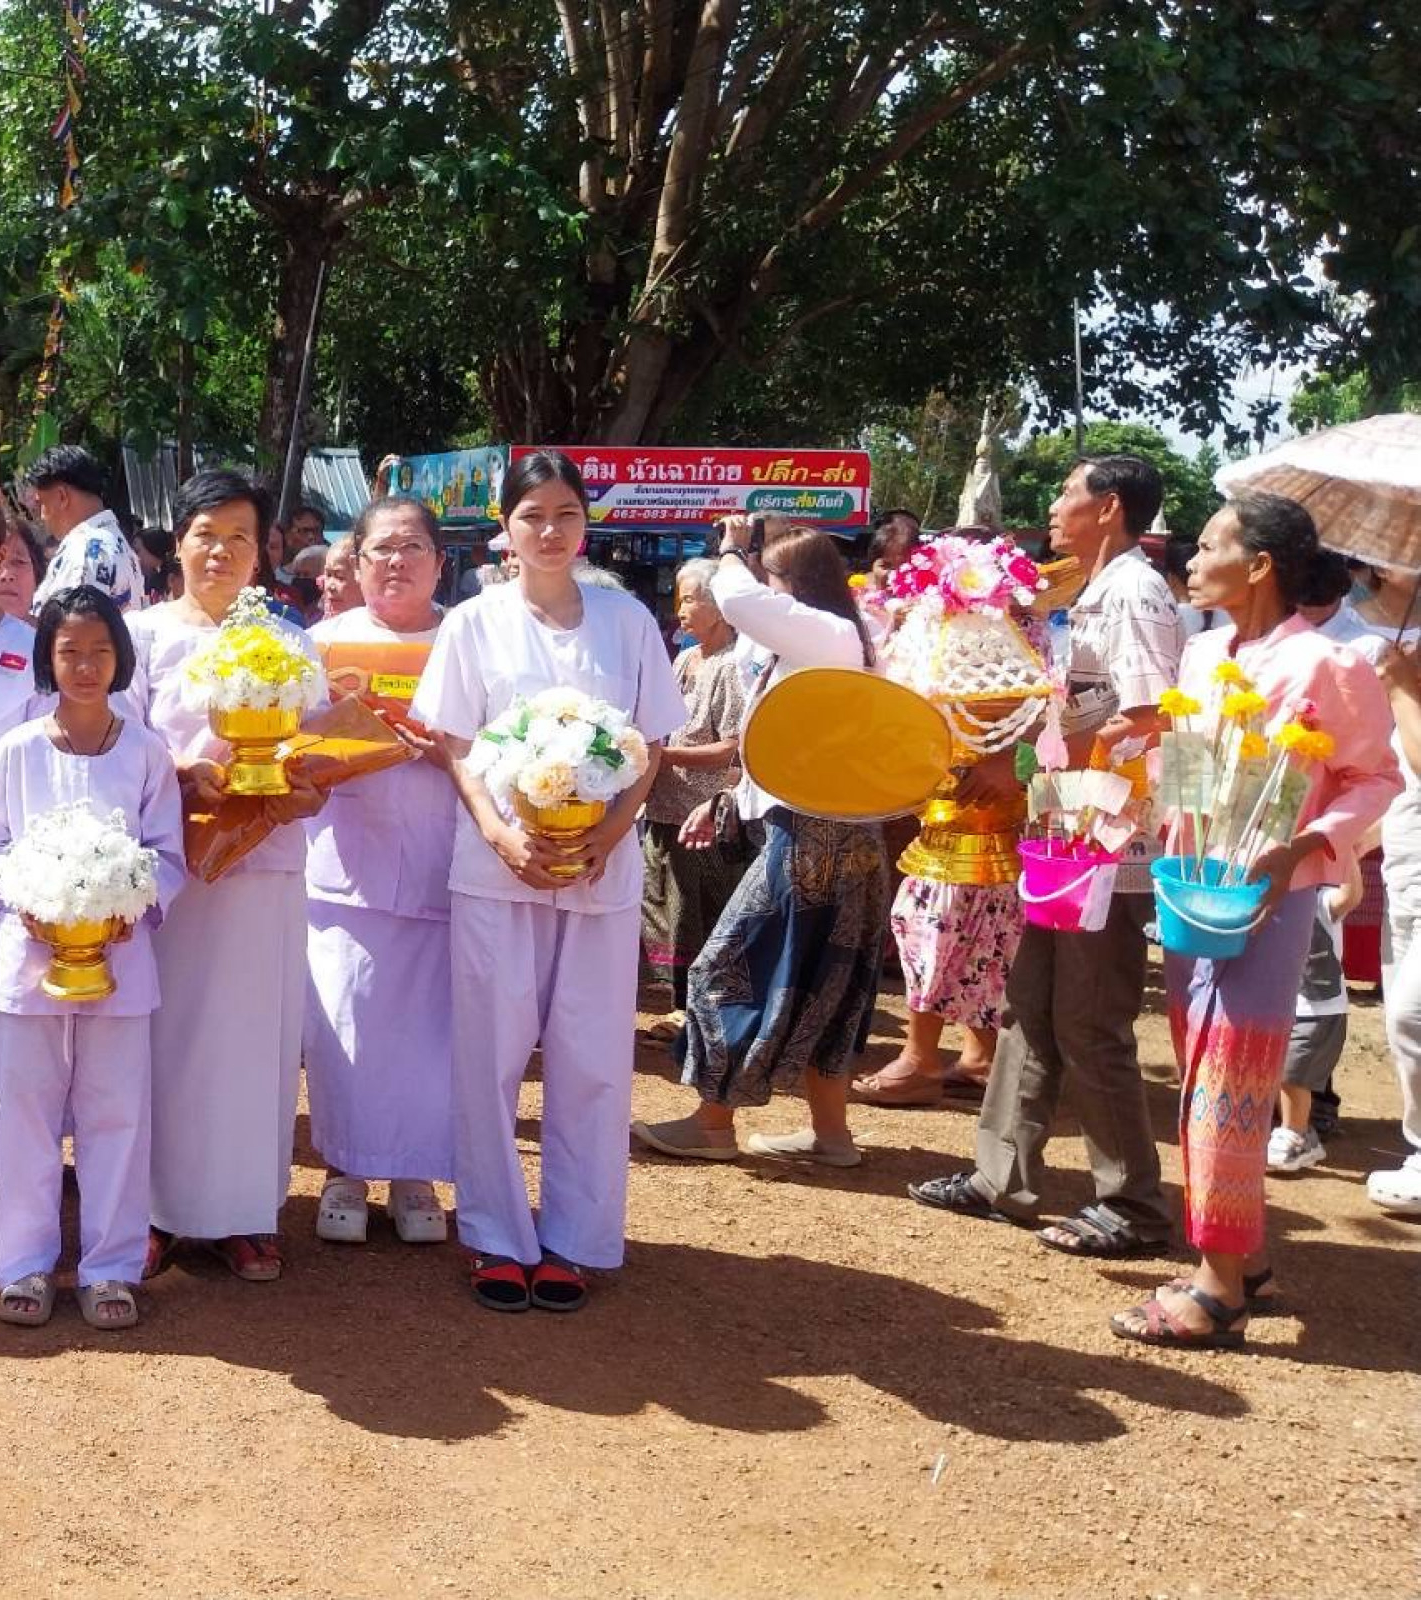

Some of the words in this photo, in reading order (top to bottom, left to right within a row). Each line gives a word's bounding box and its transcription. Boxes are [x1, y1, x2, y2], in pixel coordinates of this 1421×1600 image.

[578, 456, 617, 481] ติม
[751, 458, 857, 483] ปลีก-ส่ง
